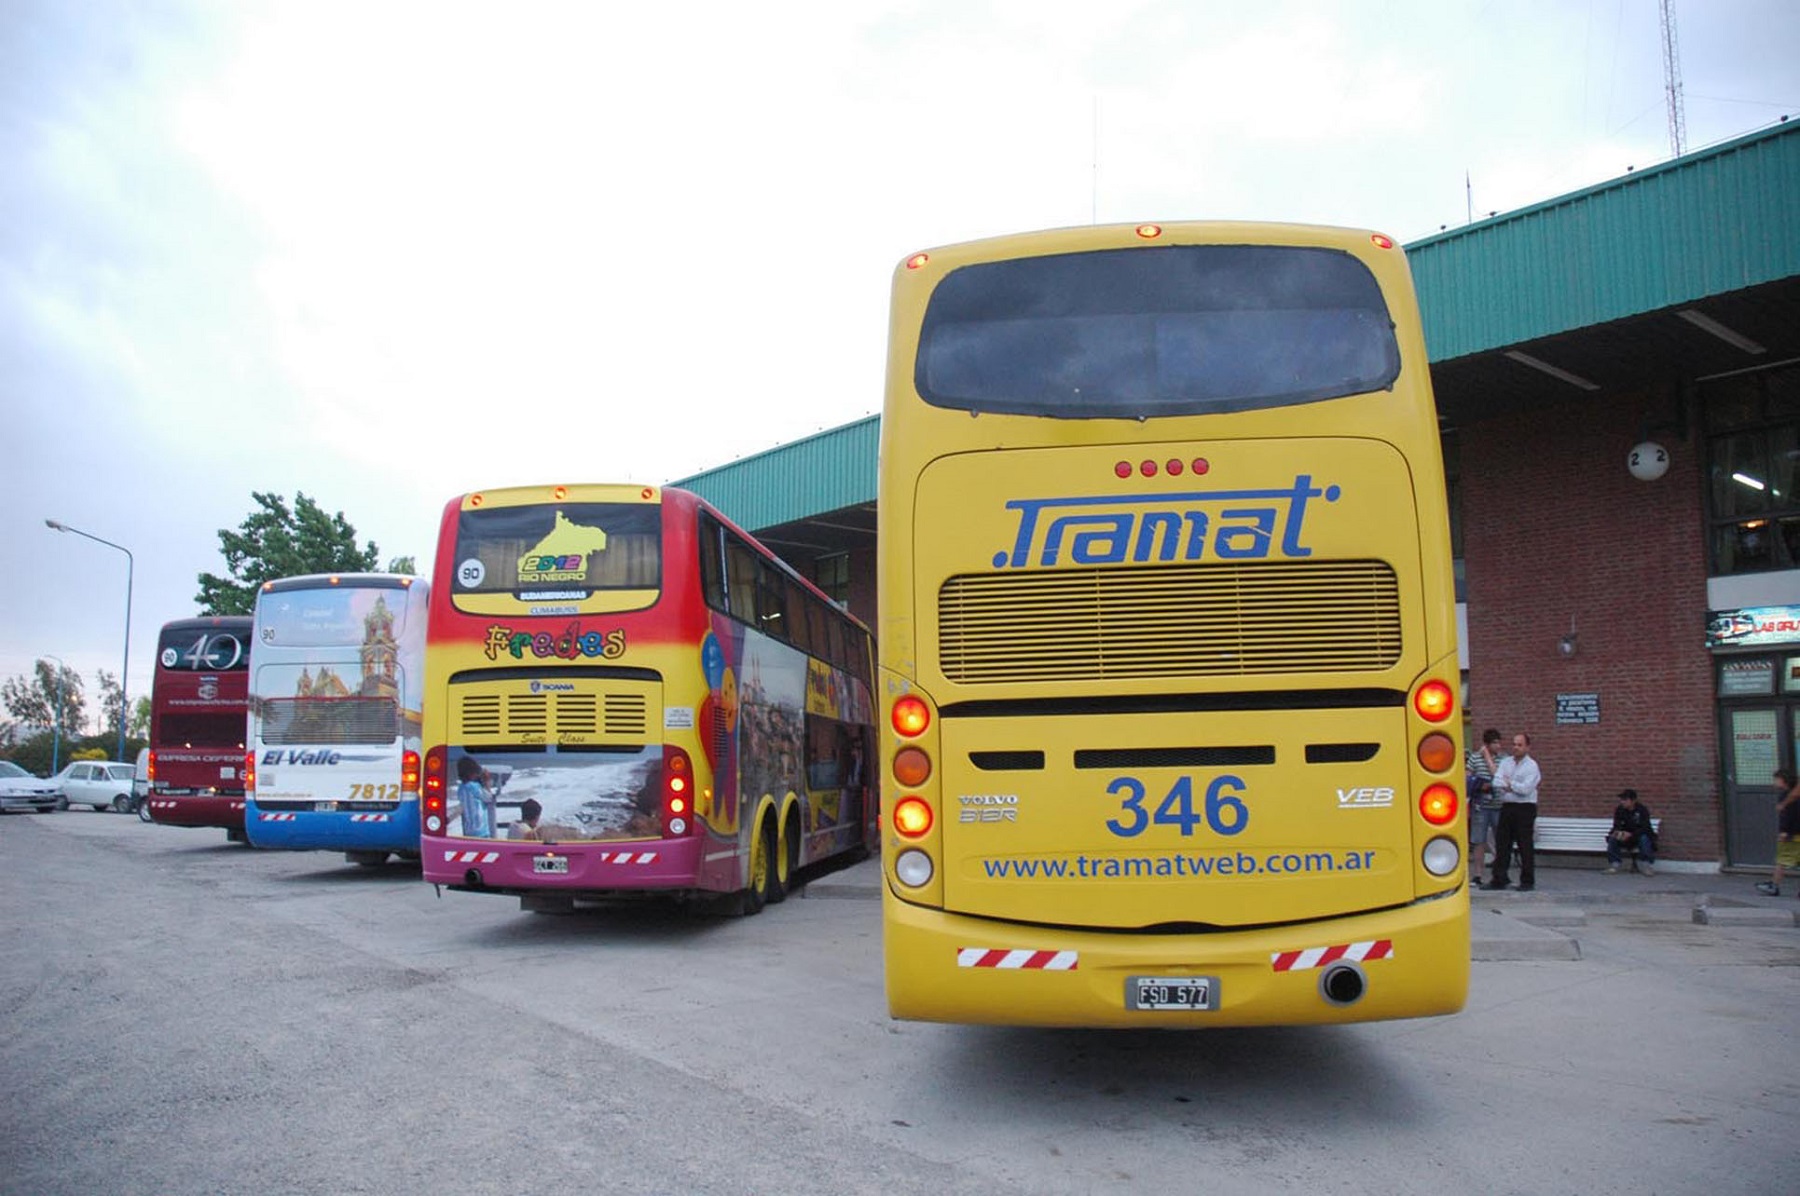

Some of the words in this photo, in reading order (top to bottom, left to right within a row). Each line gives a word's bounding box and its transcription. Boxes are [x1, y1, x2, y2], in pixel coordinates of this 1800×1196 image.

[1631, 452, 1640, 467] 2
[1656, 449, 1666, 462] 2
[1000, 475, 1330, 568] Tramat
[522, 554, 582, 572] 2012
[463, 568, 480, 580] 90
[518, 573, 539, 582] RIO
[541, 572, 586, 582] NEGRO
[484, 620, 626, 661] Fredes
[184, 633, 242, 670] 40
[261, 751, 282, 766] El
[288, 751, 341, 766] Valle
[349, 783, 400, 800] 7812
[957, 794, 1018, 805] VOLVO
[1336, 787, 1395, 803] VEB
[1106, 776, 1249, 838] 346
[983, 850, 1376, 878] www.tramatweb.com.ar
[1177, 986, 1206, 1003] 577
